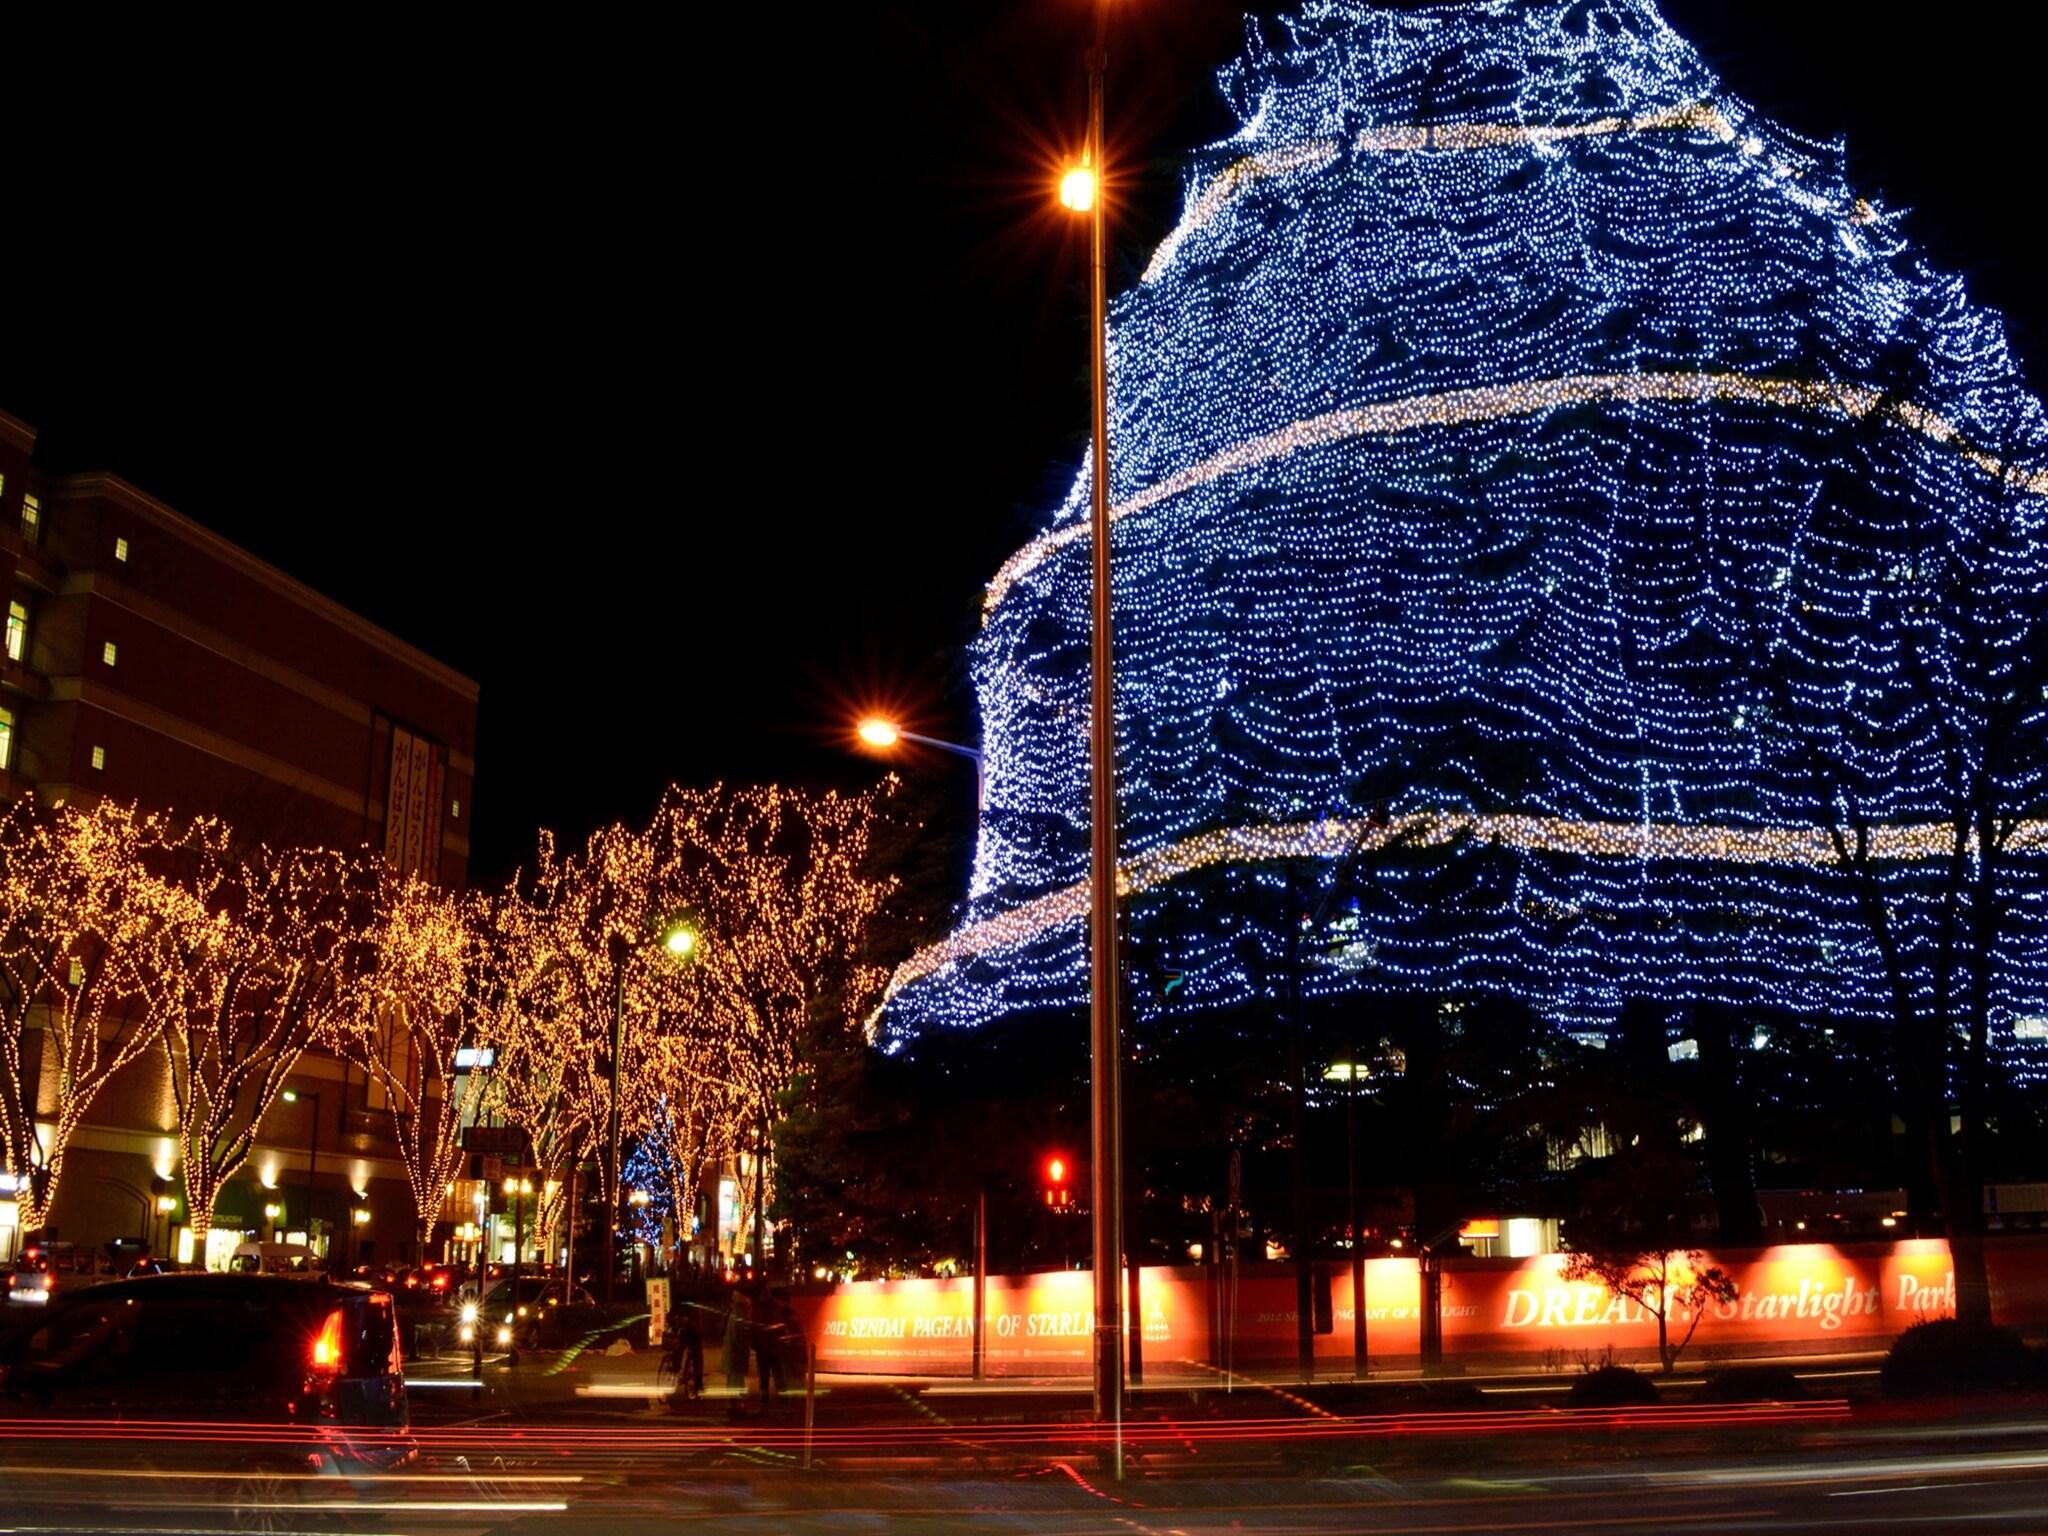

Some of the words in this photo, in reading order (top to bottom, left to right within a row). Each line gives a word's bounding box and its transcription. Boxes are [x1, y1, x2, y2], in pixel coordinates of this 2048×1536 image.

[1896, 1271, 1957, 1311] Park
[824, 1320, 848, 1336] 2012
[849, 1316, 906, 1338] SENDAI
[911, 1315, 992, 1338] PAGEAN
[997, 1313, 1021, 1337] OF
[1392, 1307, 1409, 1319] OF
